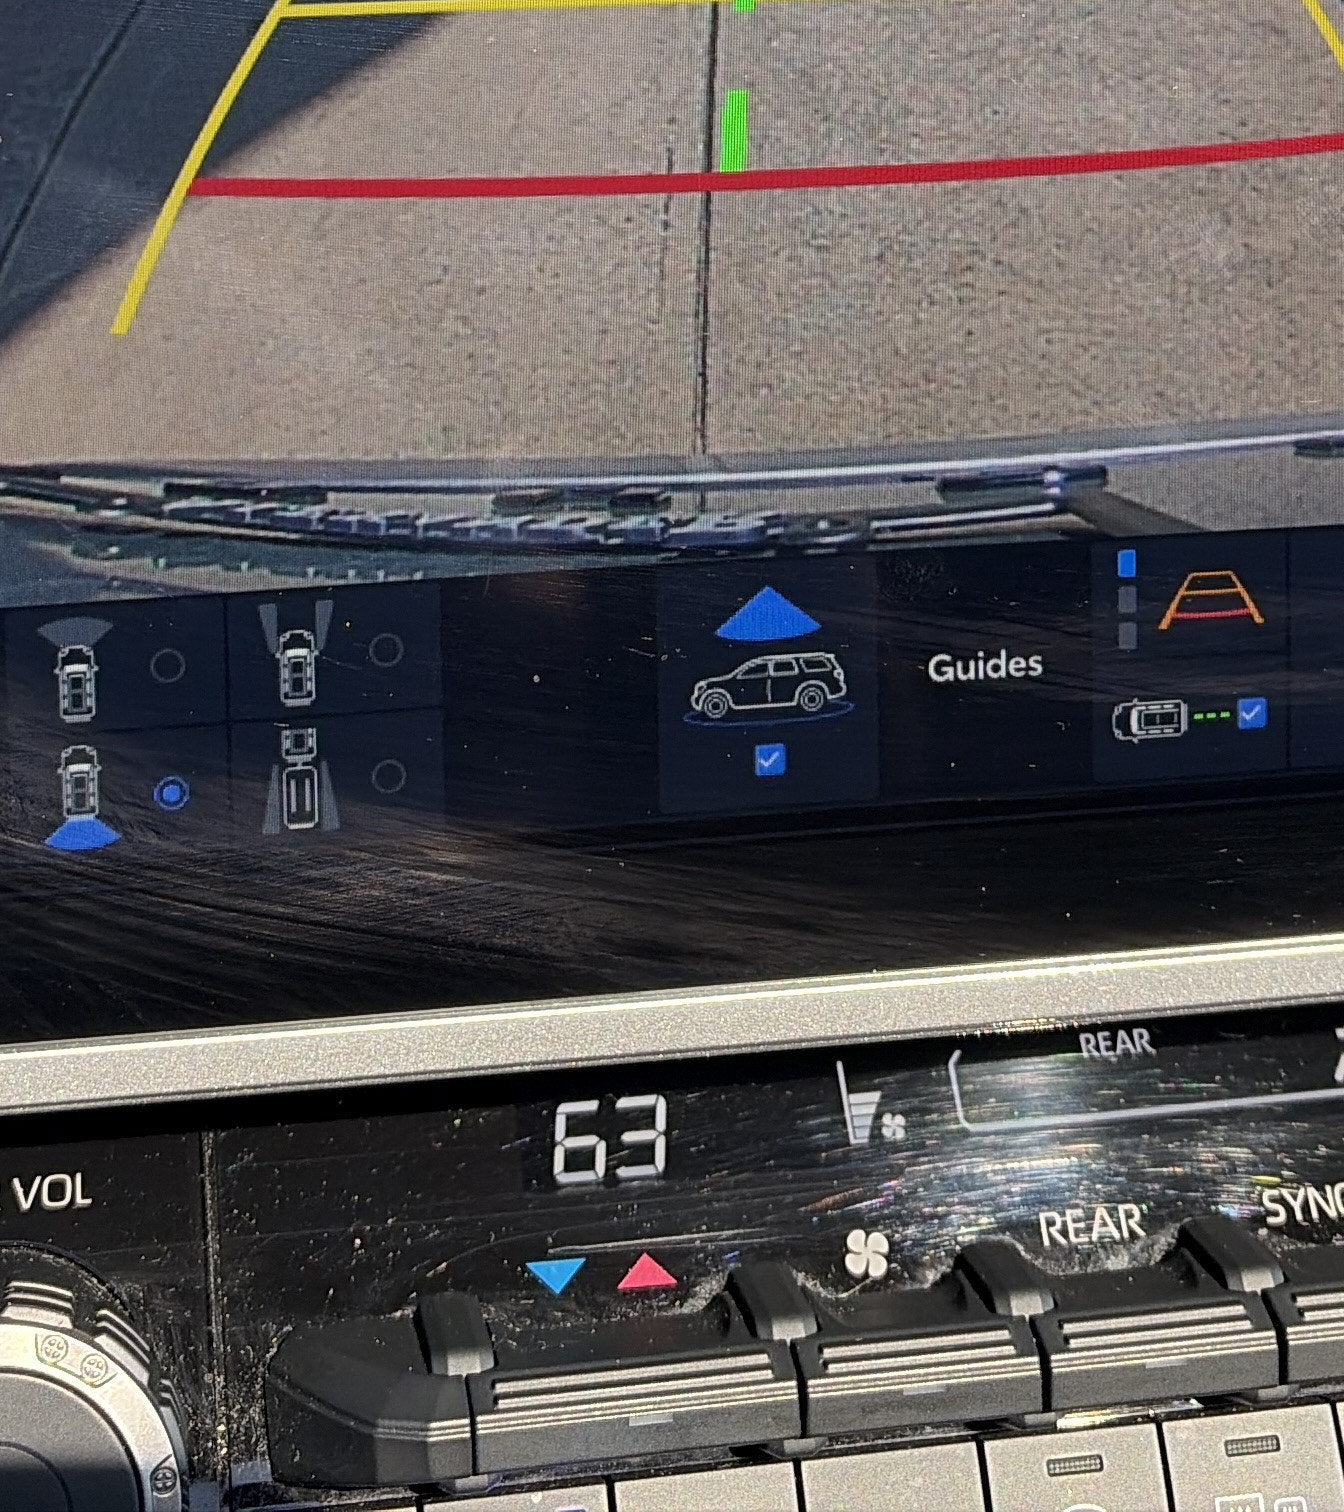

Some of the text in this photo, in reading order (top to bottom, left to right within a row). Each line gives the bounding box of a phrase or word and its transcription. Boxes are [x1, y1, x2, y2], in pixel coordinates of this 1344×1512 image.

[927, 650, 1044, 686] Guides
[1079, 1027, 1157, 1059] REAR
[553, 1093, 668, 1185] 63
[10, 1172, 93, 1211] VOL
[1038, 1204, 1146, 1247] REAR
